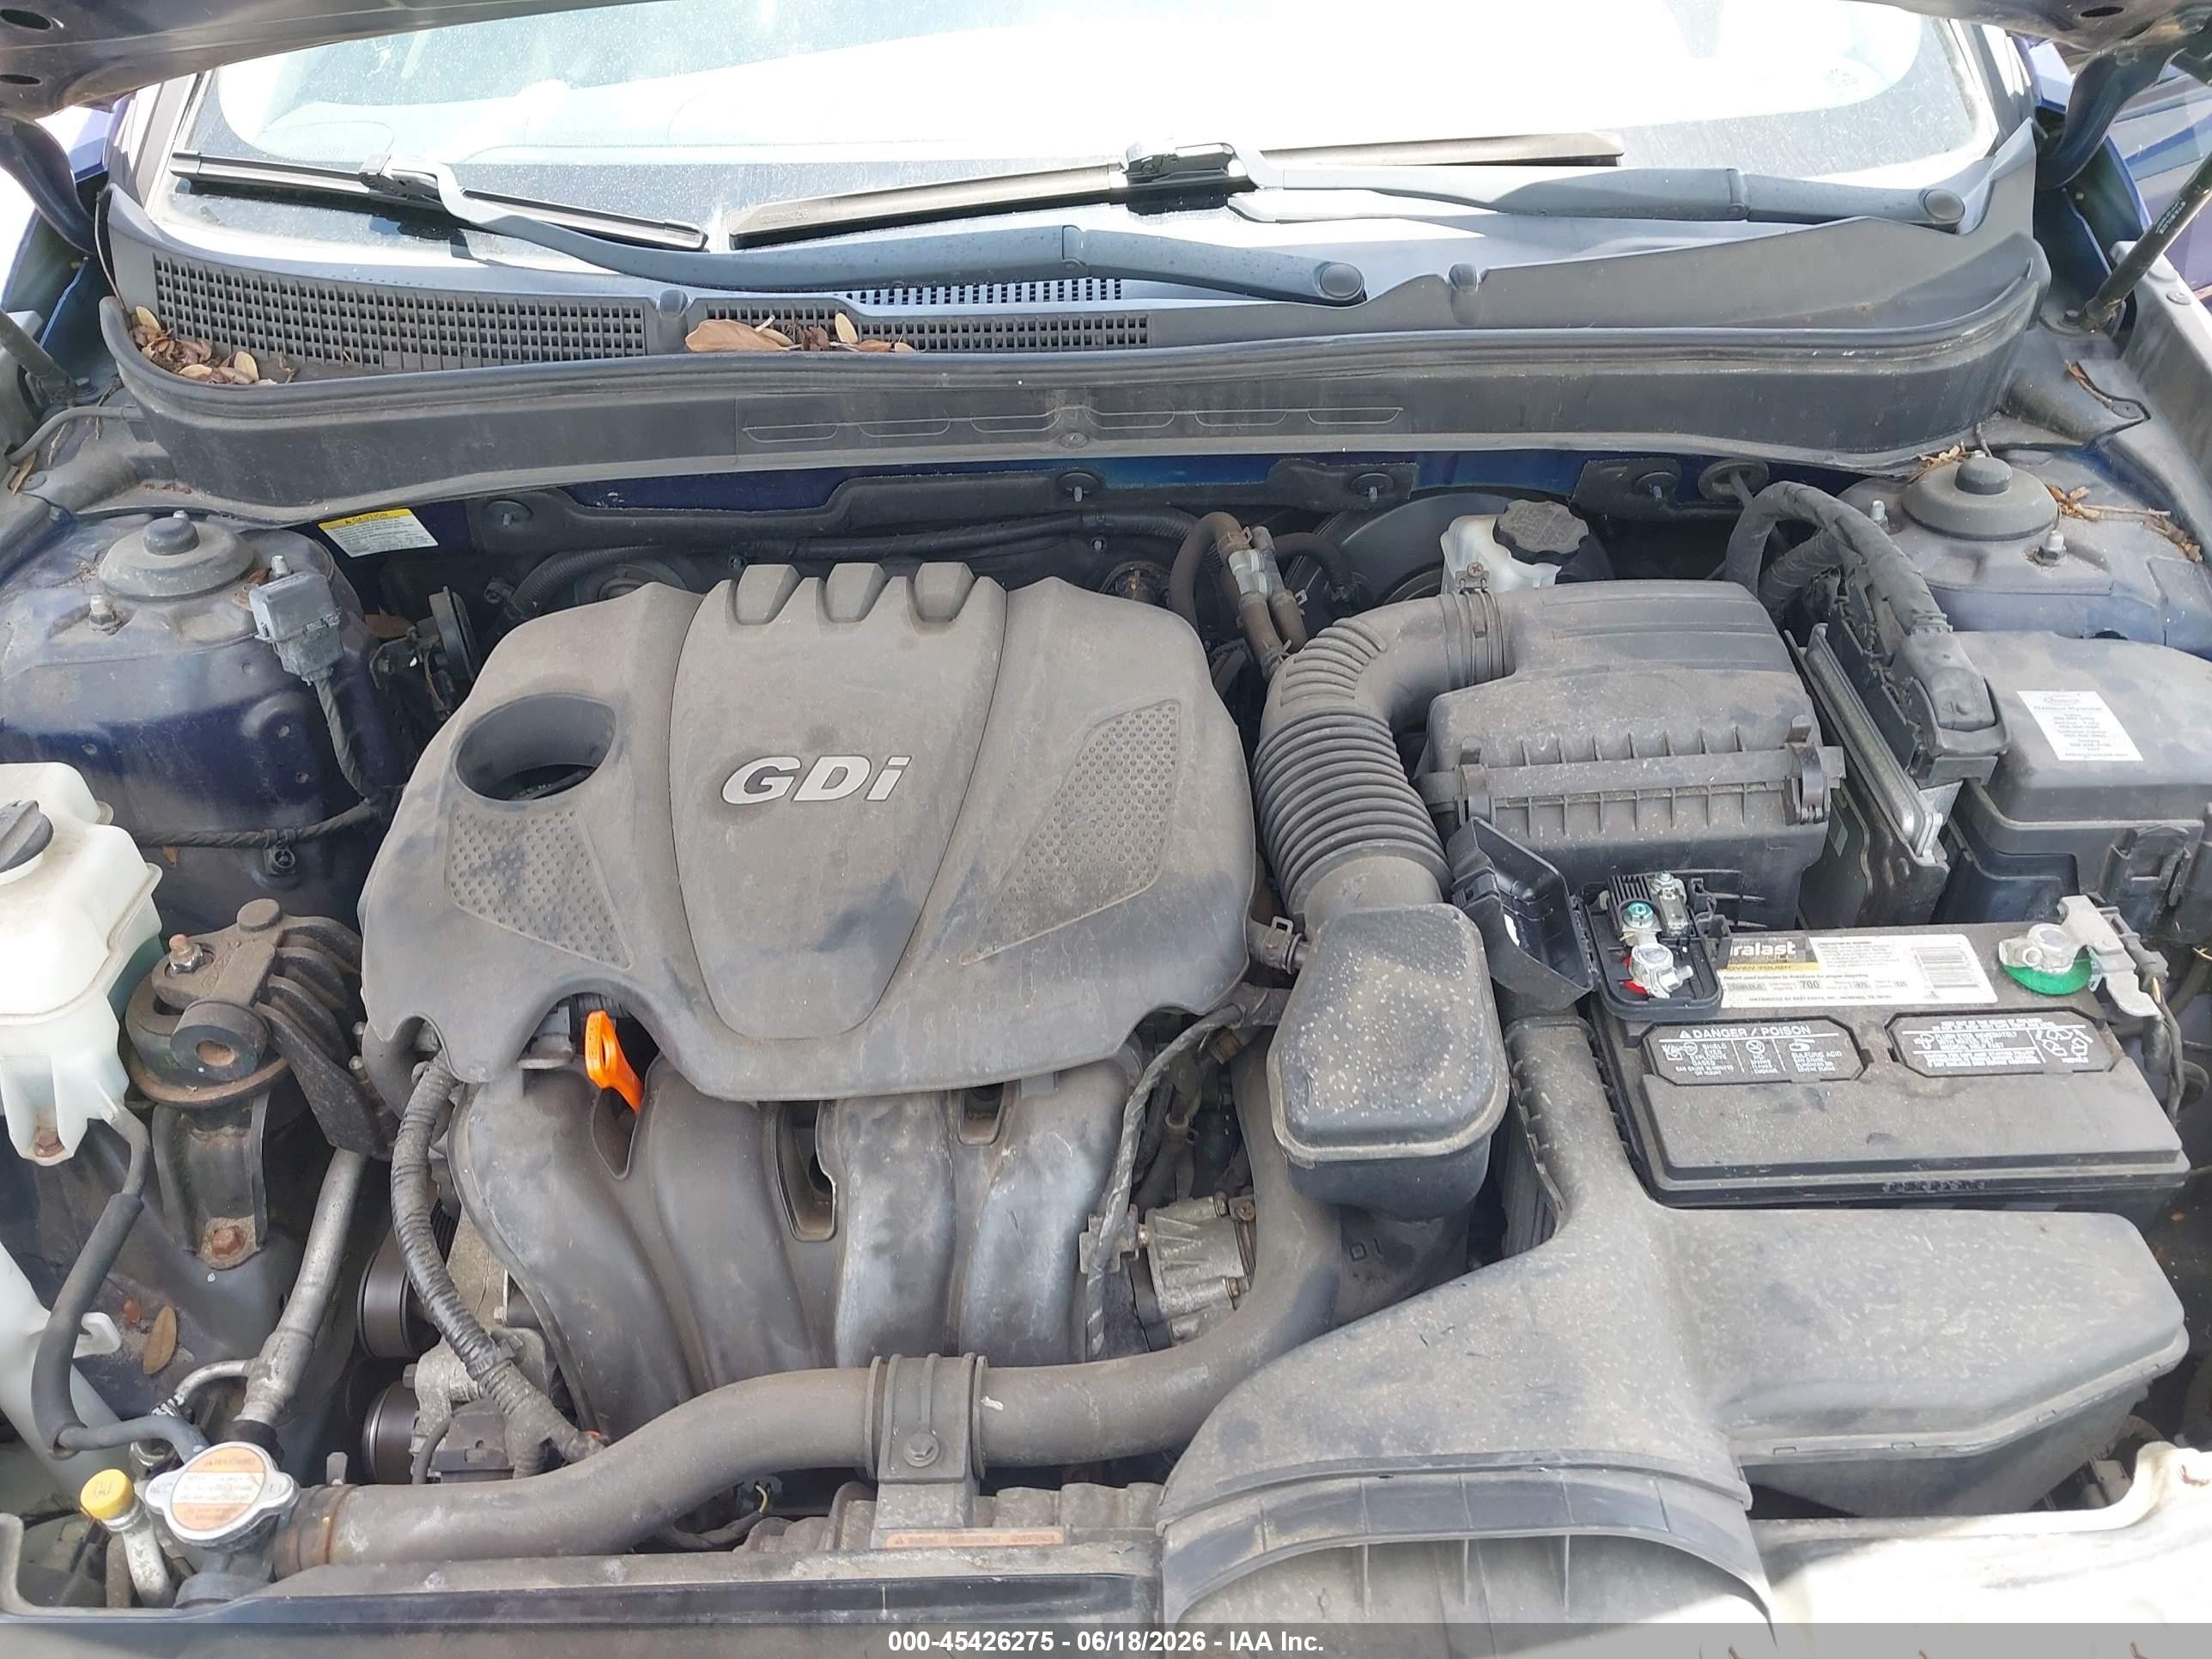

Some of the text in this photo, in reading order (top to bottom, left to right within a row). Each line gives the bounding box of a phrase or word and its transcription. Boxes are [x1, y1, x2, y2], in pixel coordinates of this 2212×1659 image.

[720, 756, 913, 805] GDi
[1799, 981, 1820, 989] 700
[1692, 1024, 1812, 1039] DANGER / POISON
